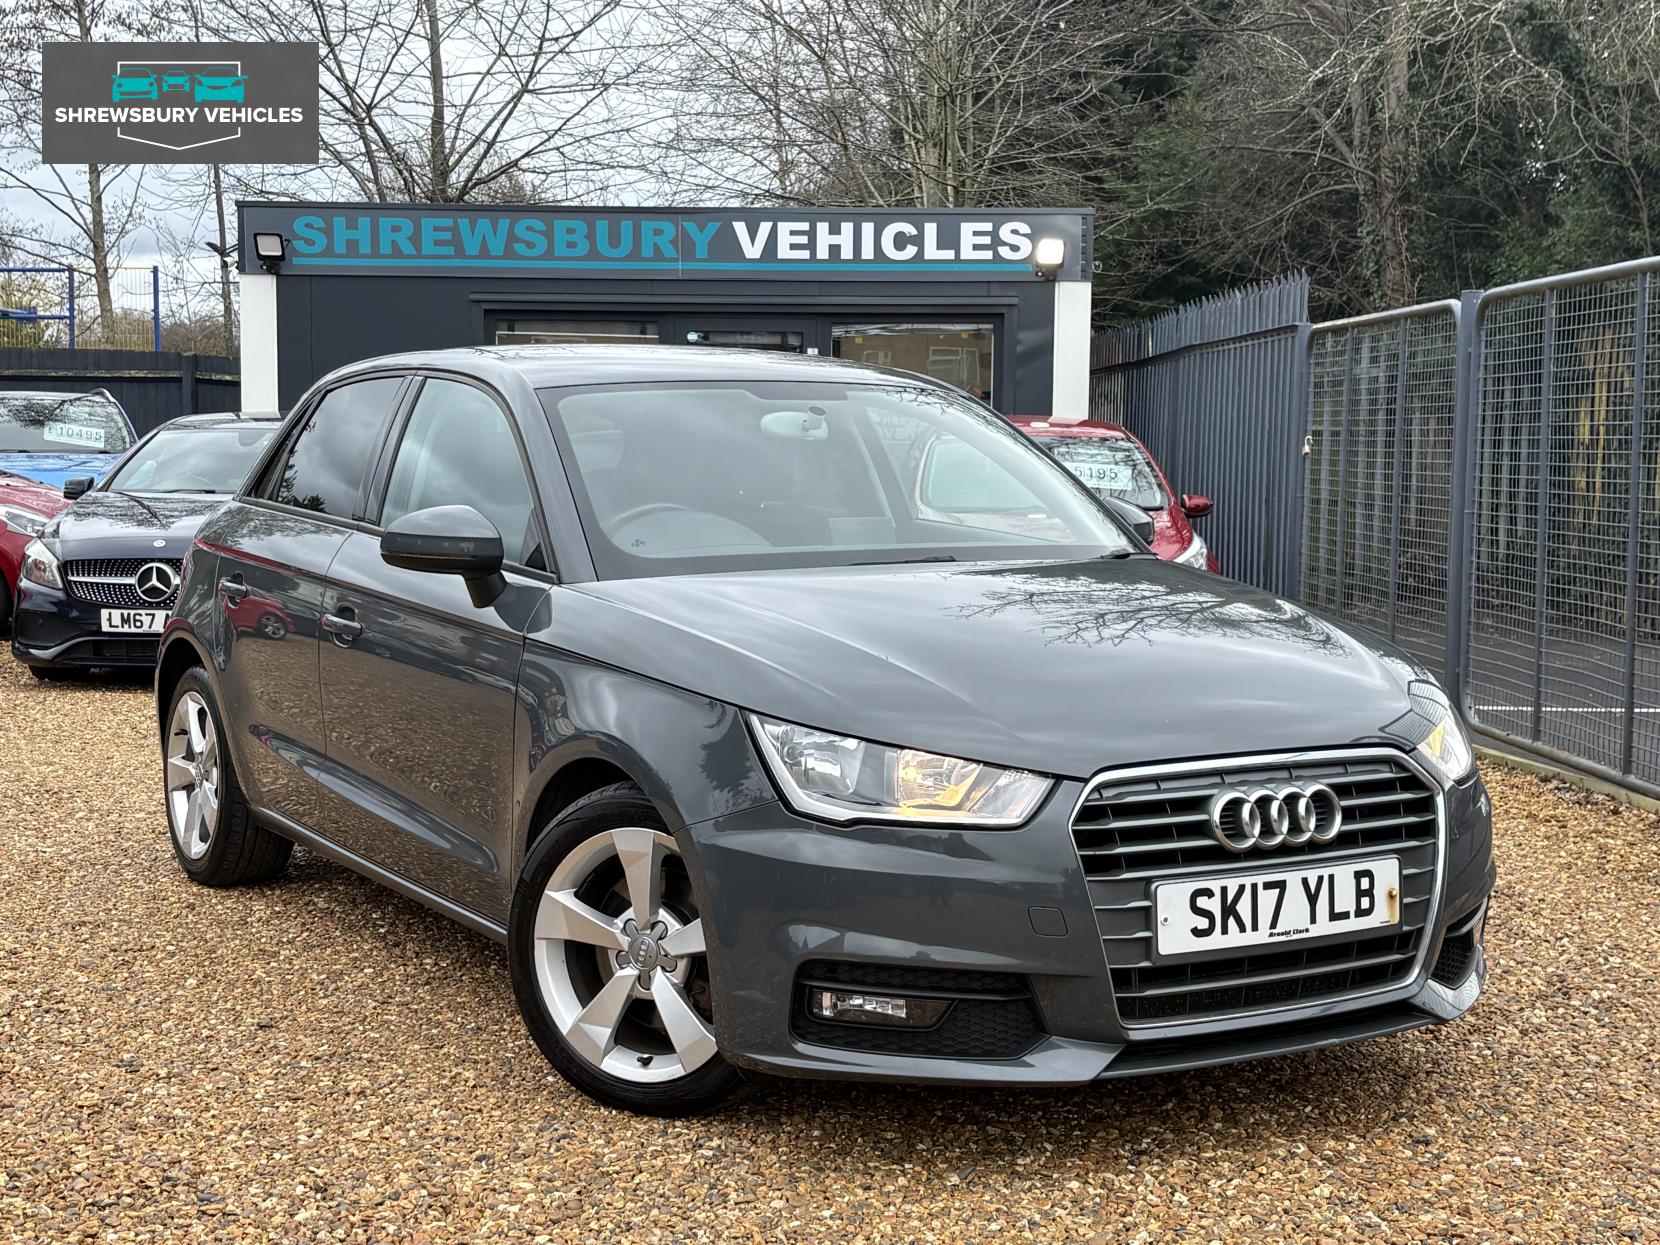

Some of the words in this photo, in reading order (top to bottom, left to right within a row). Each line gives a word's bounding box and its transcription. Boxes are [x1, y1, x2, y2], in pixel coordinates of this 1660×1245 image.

[292, 215, 722, 259] SHREWSBURY
[731, 221, 1034, 261] VEHICLES
[106, 611, 156, 629] LM67
[1189, 879, 1287, 939] SK17
[1301, 869, 1376, 926] YLB
[1268, 930, 1291, 938] Arnold
[1292, 927, 1310, 935] Clark
